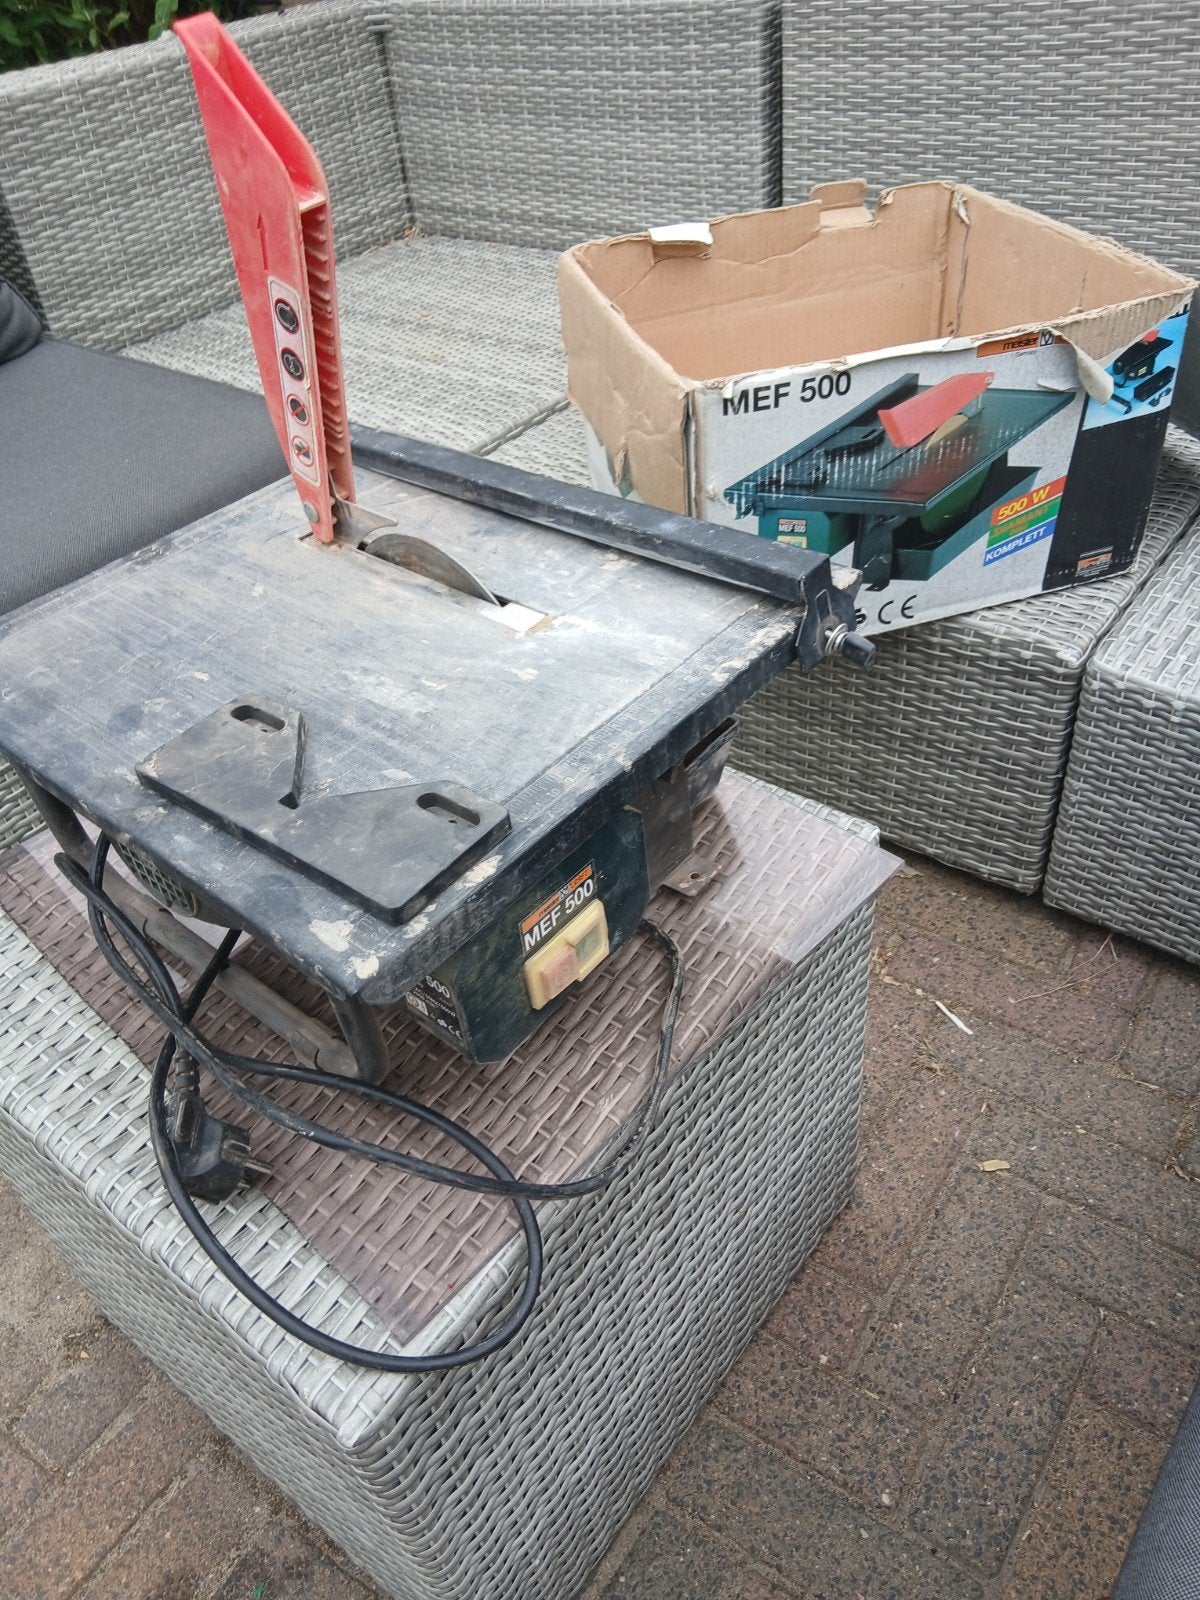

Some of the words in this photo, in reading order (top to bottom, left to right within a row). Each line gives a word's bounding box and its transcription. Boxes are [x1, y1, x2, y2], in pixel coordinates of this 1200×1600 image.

[722, 382, 791, 416] MEF
[800, 371, 851, 403] 500
[997, 497, 1028, 520] 500
[1032, 485, 1051, 504] W
[985, 526, 1047, 562] KOMPLETT
[523, 904, 561, 952] MEF
[565, 878, 594, 914] 500
[425, 975, 451, 998] 500
